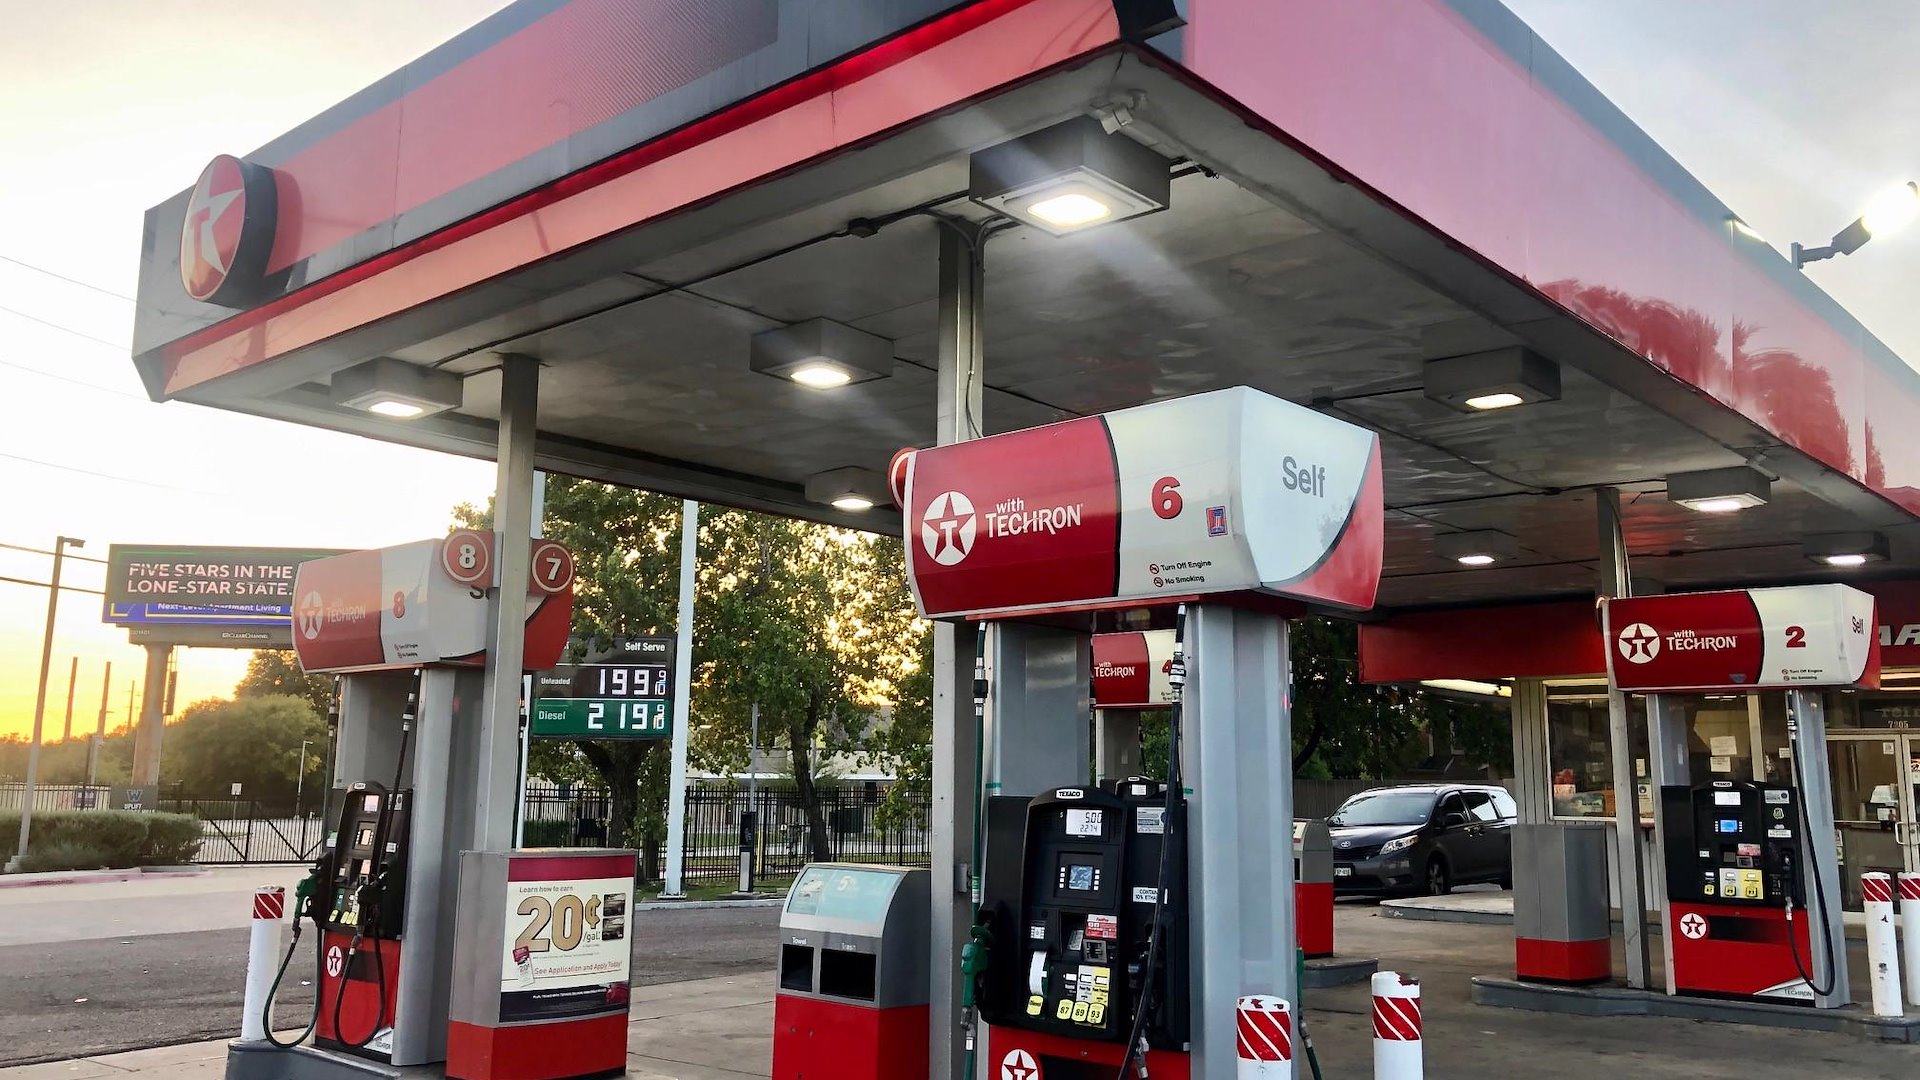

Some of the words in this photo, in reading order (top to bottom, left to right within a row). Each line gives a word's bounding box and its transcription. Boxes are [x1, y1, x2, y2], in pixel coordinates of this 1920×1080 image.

[1282, 455, 1326, 498] Self
[995, 497, 1025, 514] with
[1151, 476, 1184, 520] 6
[984, 503, 1082, 538] TECHRON
[458, 544, 477, 569] 8
[128, 563, 170, 577] FIVE
[174, 564, 230, 578] STARS
[234, 565, 253, 578] IN
[258, 565, 293, 579] THE
[546, 557, 562, 581] 7
[1188, 560, 1212, 569] Engine
[1175, 575, 1205, 583] Smoking
[127, 580, 231, 594] LONE-STAR
[235, 581, 293, 595] STATE.
[157, 603, 206, 611] Next-Le
[255, 604, 281, 613] Living
[393, 591, 406, 619] 8
[1673, 629, 1696, 638] with
[1785, 625, 1806, 648] 2
[624, 642, 641, 652] Self
[642, 642, 666, 652] Serve
[1665, 635, 1738, 652] TECHRON
[1094, 666, 1136, 678] TECHRON
[540, 677, 571, 685] Unleaded
[538, 710, 566, 720] Diesel
[792, 936, 807, 945] Towel
